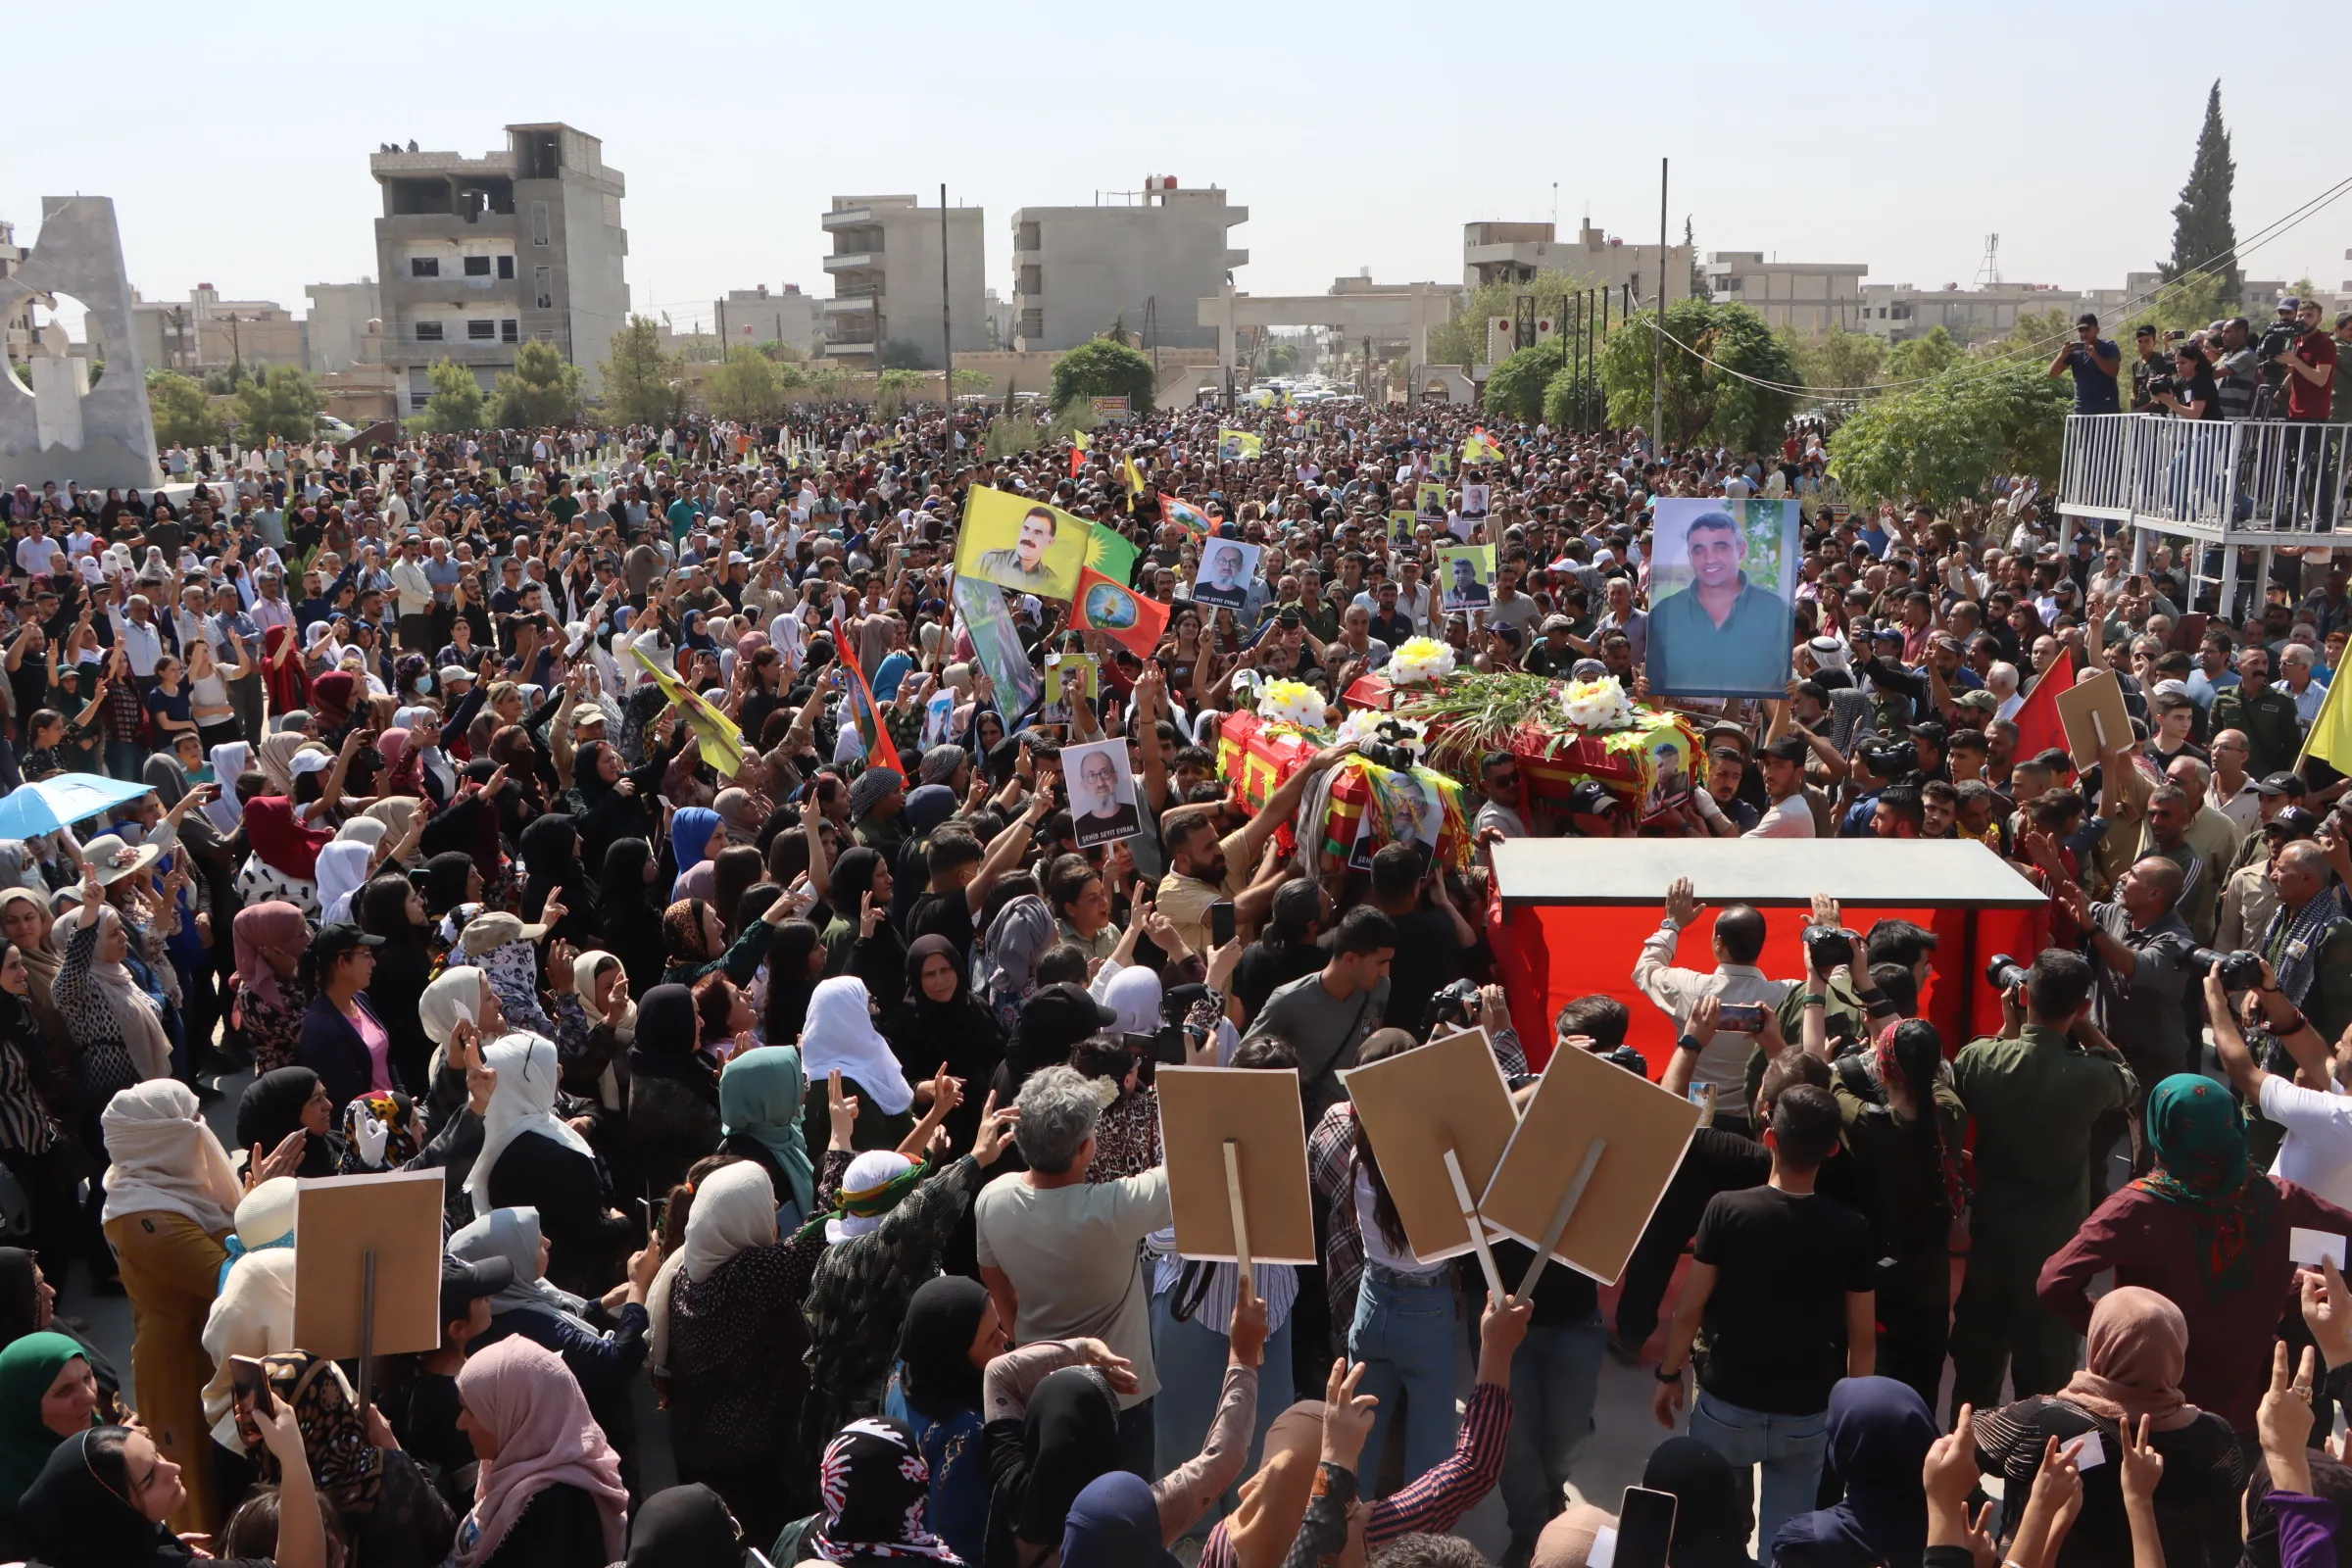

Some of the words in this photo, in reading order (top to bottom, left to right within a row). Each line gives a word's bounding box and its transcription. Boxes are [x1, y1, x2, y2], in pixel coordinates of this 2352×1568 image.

[1081, 833, 1099, 844] ŞEHİD
[1116, 825, 1134, 835] EVRAN
[1357, 856, 1371, 864] ŞEH
